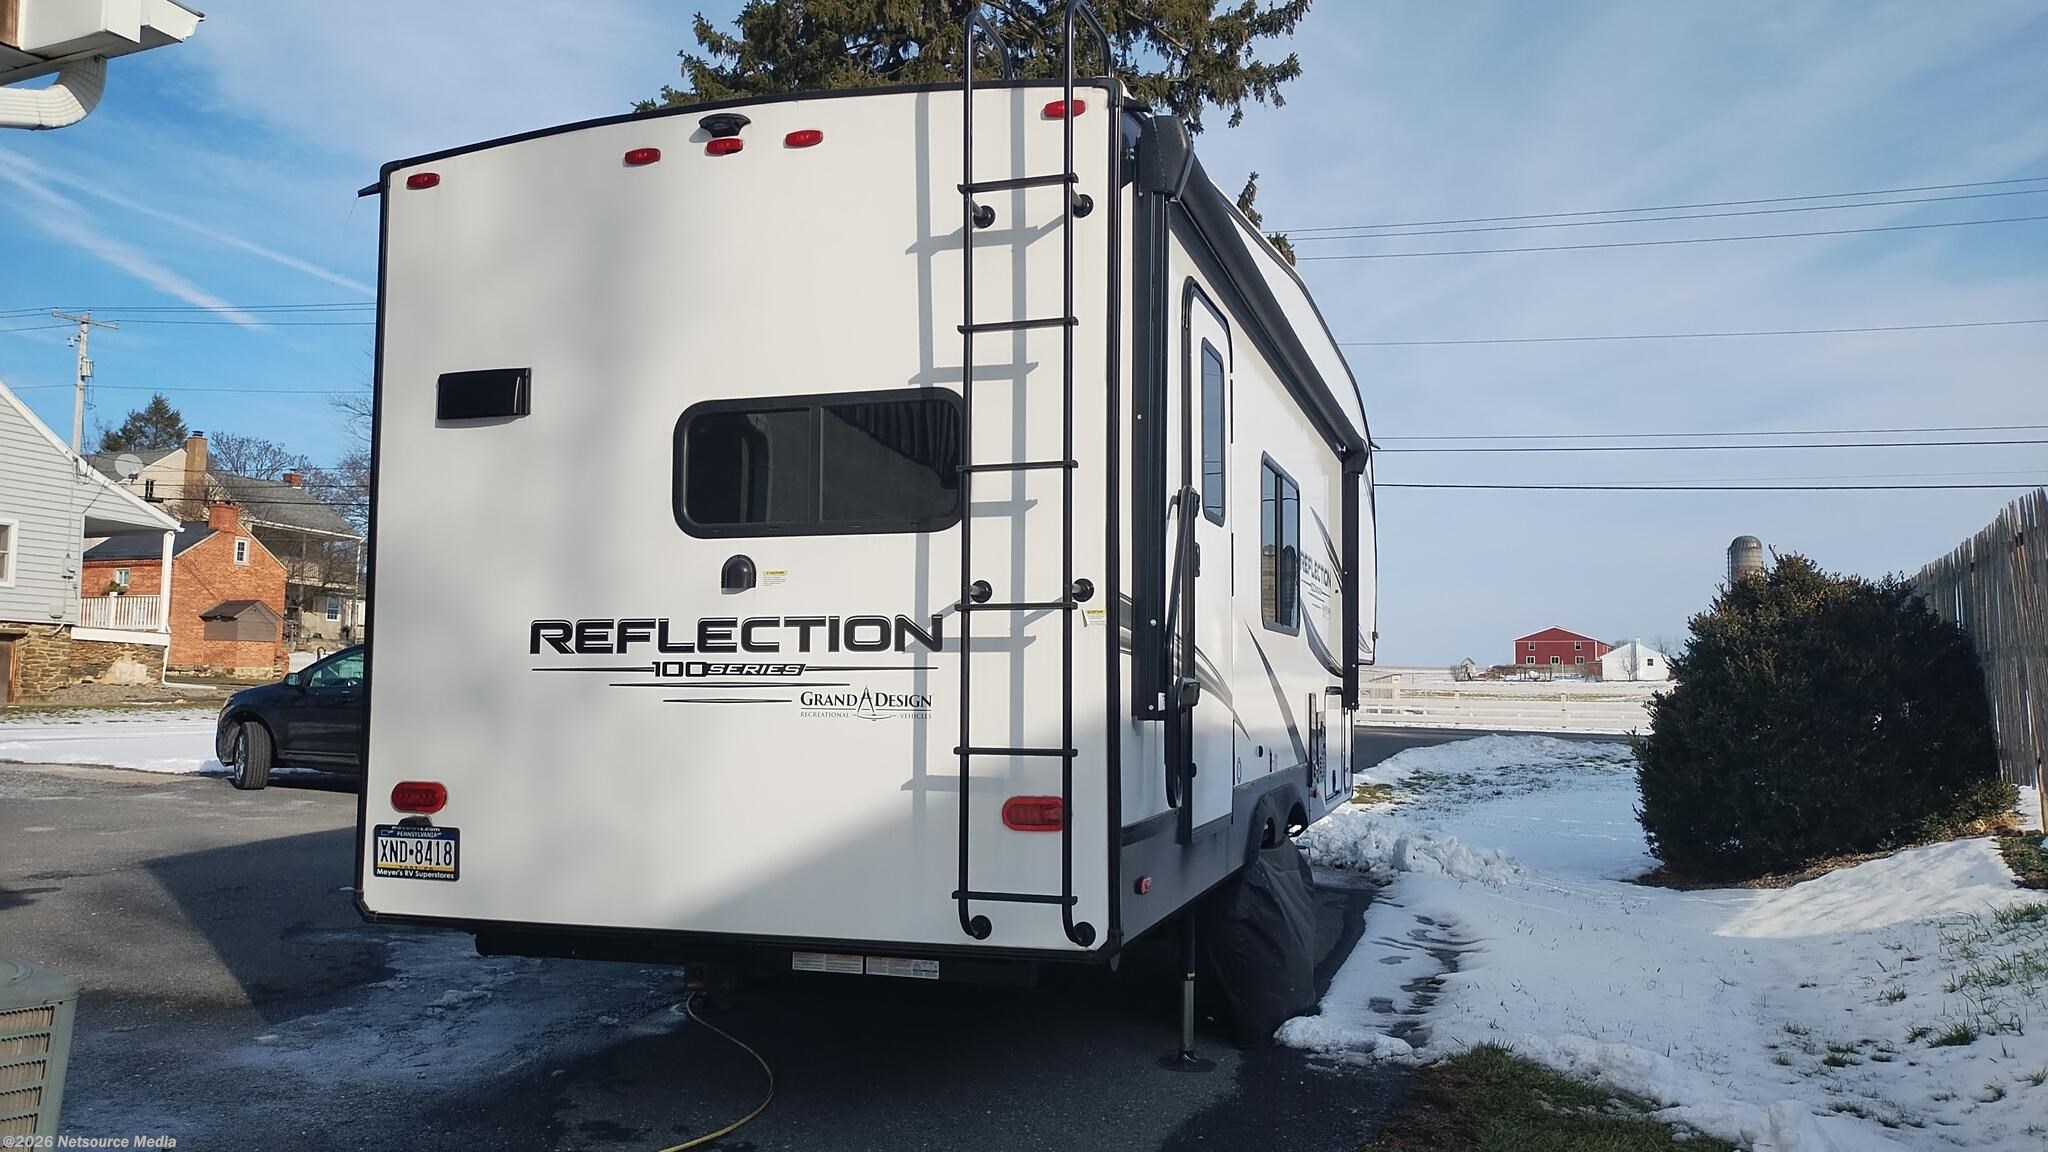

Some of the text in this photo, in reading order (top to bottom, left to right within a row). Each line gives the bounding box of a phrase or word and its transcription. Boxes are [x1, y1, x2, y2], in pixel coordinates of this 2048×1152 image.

[529, 614, 943, 655] REFLECTION
[652, 661, 801, 677] 100 SERIES
[800, 691, 932, 707] GRAND DESIGN
[376, 869, 403, 877] Meyer's
[415, 871, 455, 879] Superstores
